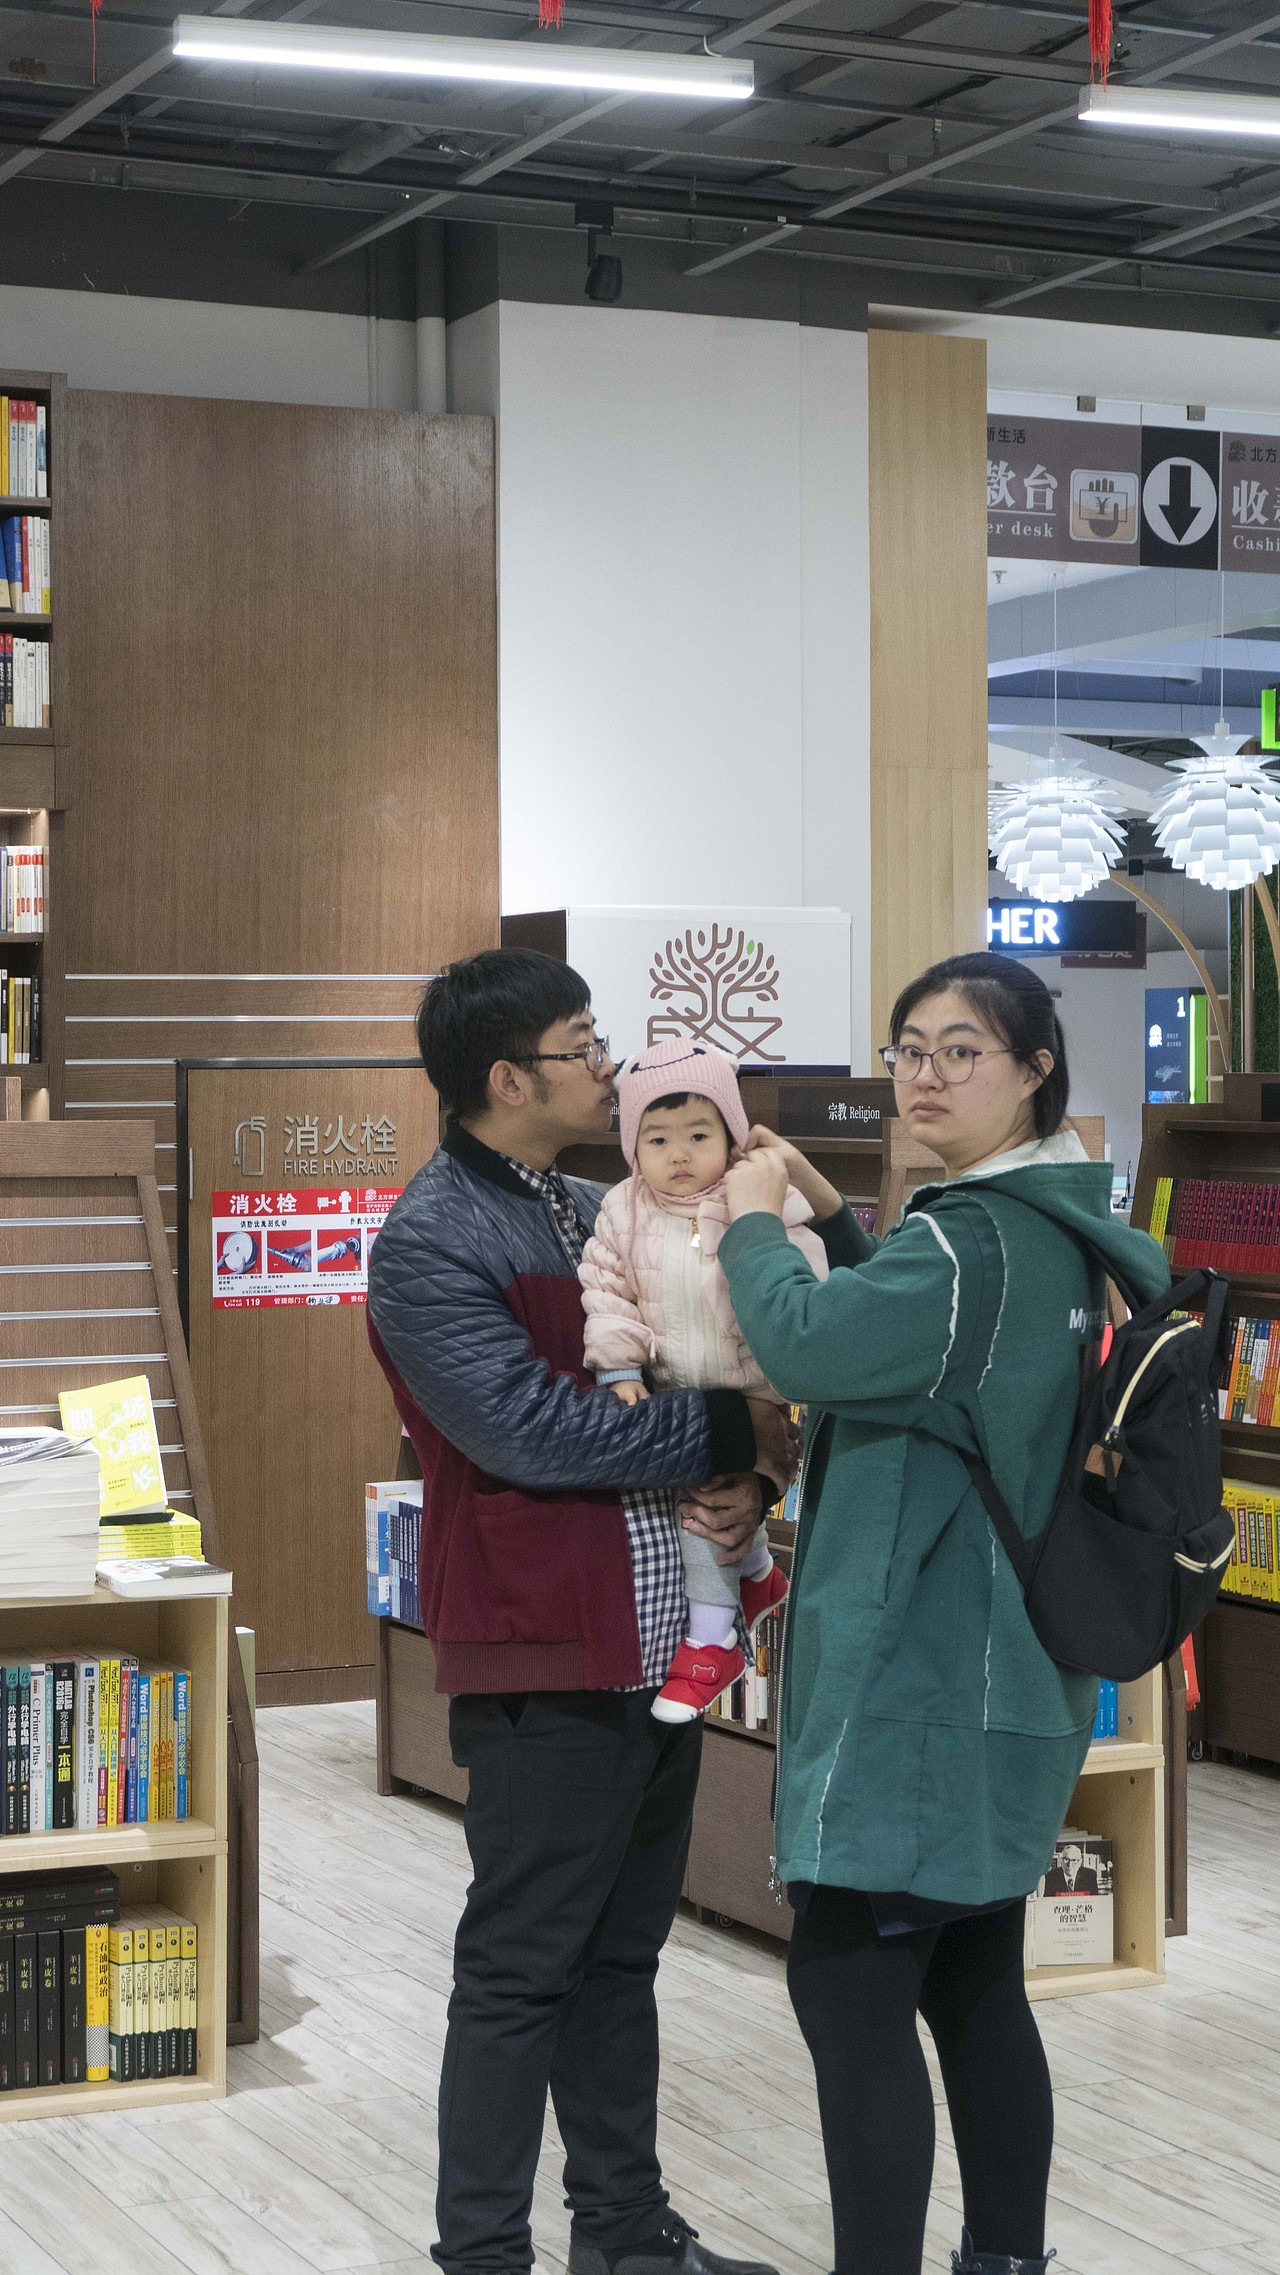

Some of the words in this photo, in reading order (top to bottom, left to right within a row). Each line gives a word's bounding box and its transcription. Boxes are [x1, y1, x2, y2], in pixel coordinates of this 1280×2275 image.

[1232, 480, 1280, 526] 收
[1012, 521, 1053, 538] desk
[1233, 534, 1280, 552] Cashi
[1176, 996, 1186, 1017] 1
[828, 1102, 847, 1121] 宗教
[850, 1106, 880, 1122] Religion
[283, 1114, 398, 1155] 消火栓
[284, 1158, 318, 1175] FIRE
[323, 1158, 398, 1175] HYDRANT
[229, 1192, 298, 1214] 消火栓
[245, 1298, 260, 1306] 119
[33, 1698, 41, 1707] C
[56, 1681, 64, 1710] R2016a
[65, 1680, 73, 1710] MATLAB
[87, 1685, 95, 1726] Photoshop
[178, 1682, 187, 1710] Word
[33, 1709, 41, 1743] Primer
[60, 1712, 68, 1744] 完全自学
[58, 1745, 71, 1782] 一本通
[1053, 1904, 1093, 1914] 查理·芒格
[1059, 1914, 1087, 1923] 的智慧
[99, 1942, 108, 1998] 石油即政治
